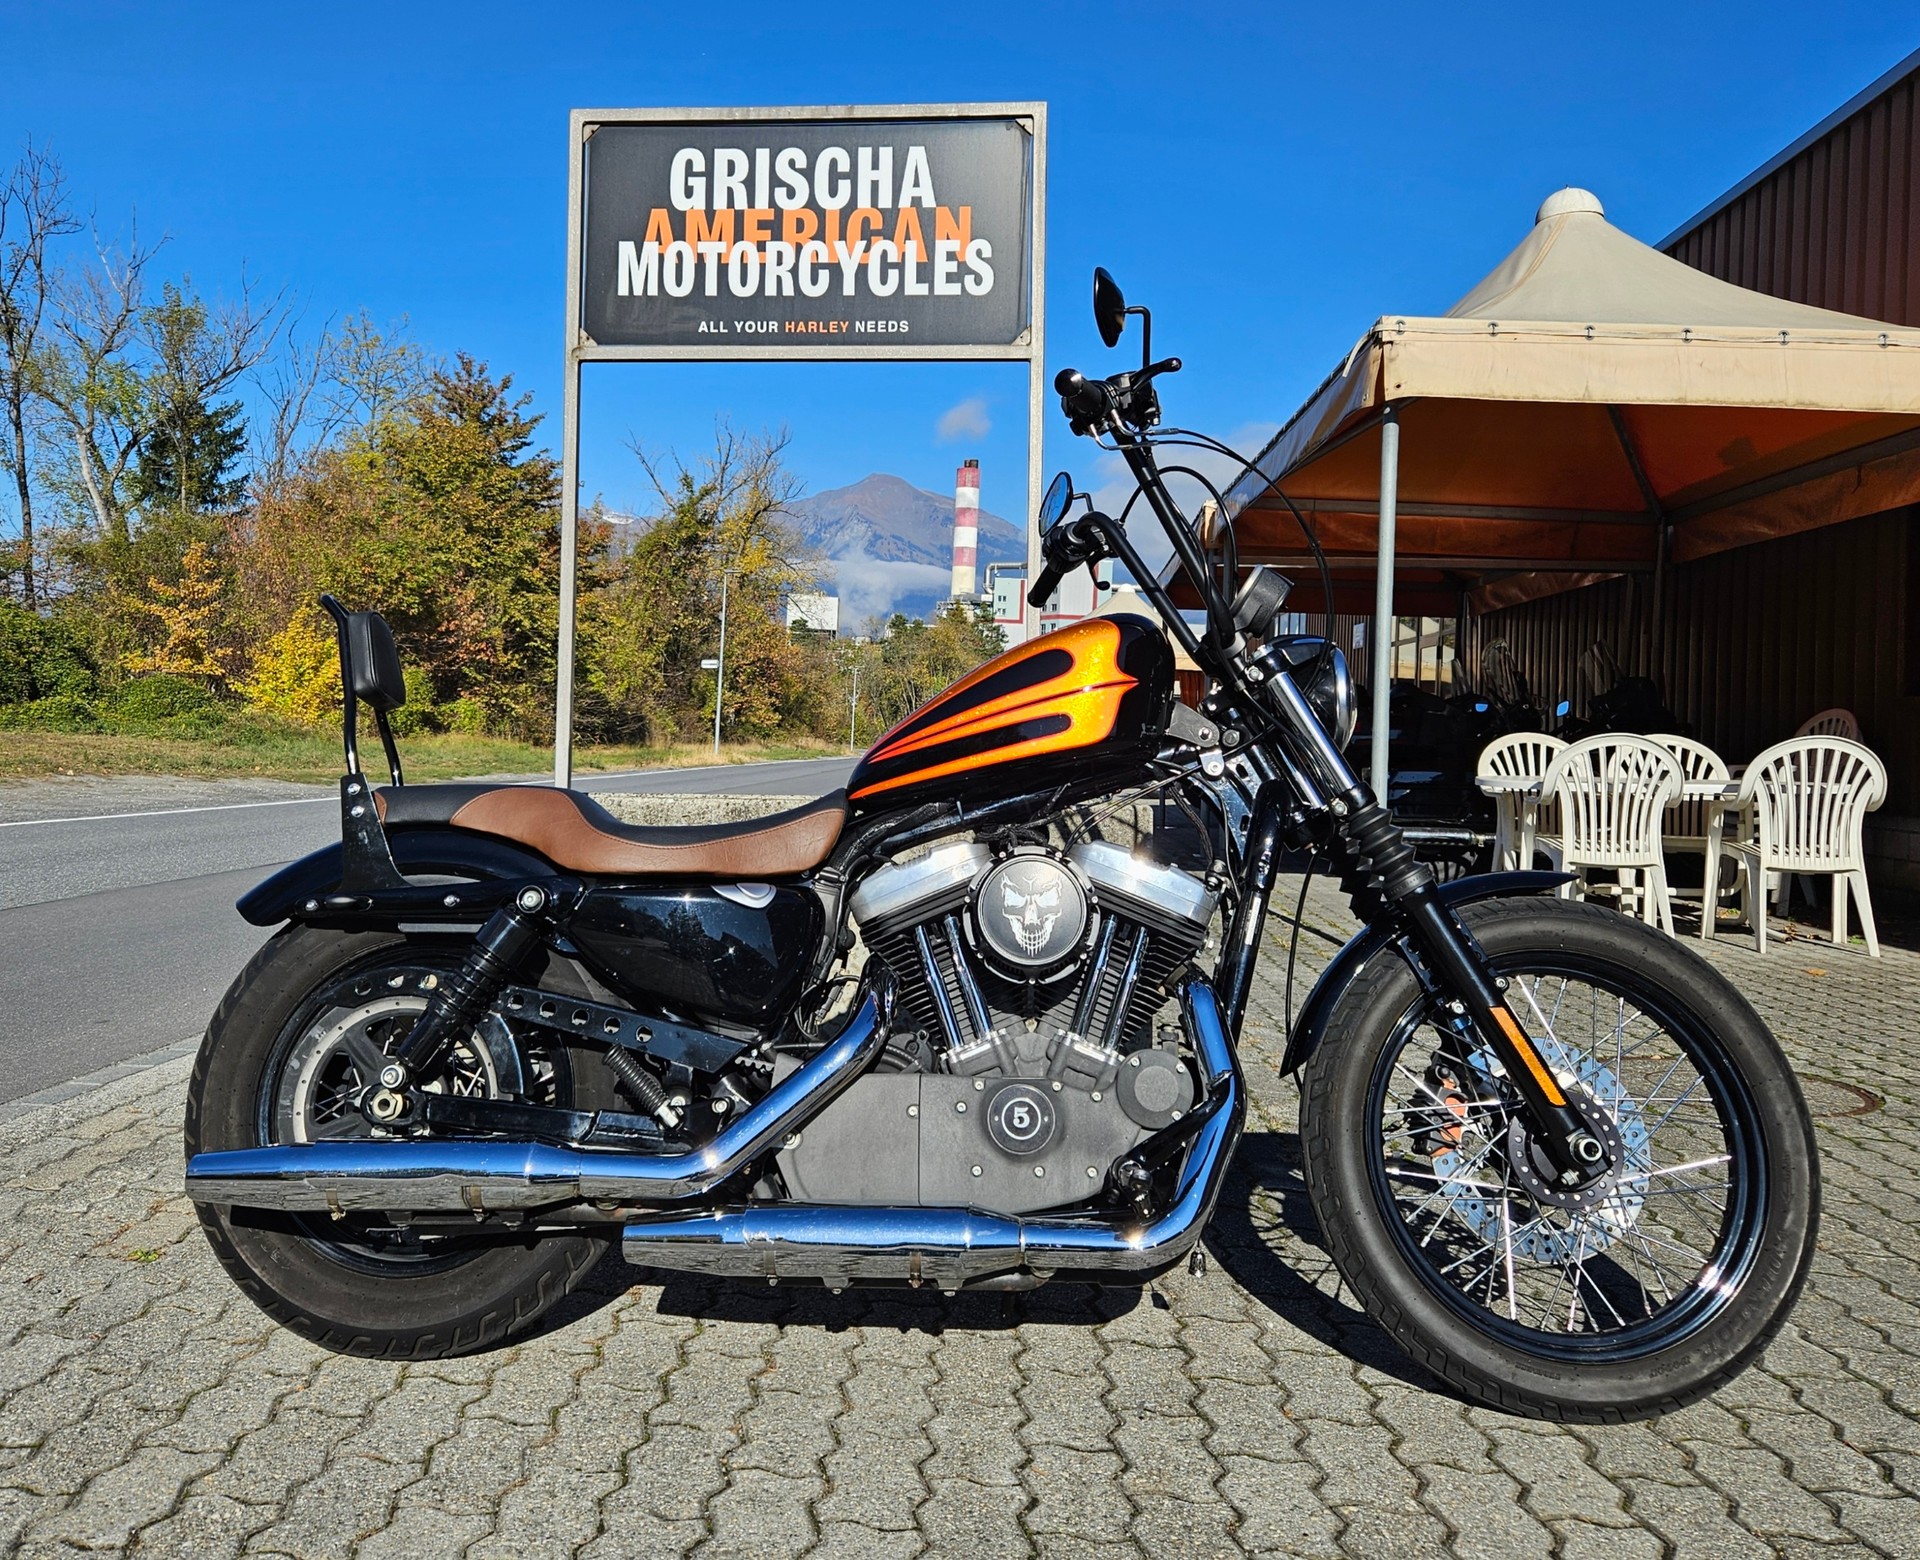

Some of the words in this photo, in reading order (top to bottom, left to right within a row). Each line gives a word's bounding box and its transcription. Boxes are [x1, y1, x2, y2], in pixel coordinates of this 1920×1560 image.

[670, 146, 936, 211] GRISCHA
[644, 206, 972, 264] AMERICAN
[618, 238, 995, 297] MOTORCYCLES
[698, 321, 728, 333] ALL
[734, 321, 779, 333] YOUR
[785, 321, 849, 333] HARLEY
[855, 320, 909, 333] NEEDS
[1013, 1106, 1030, 1129] 5
